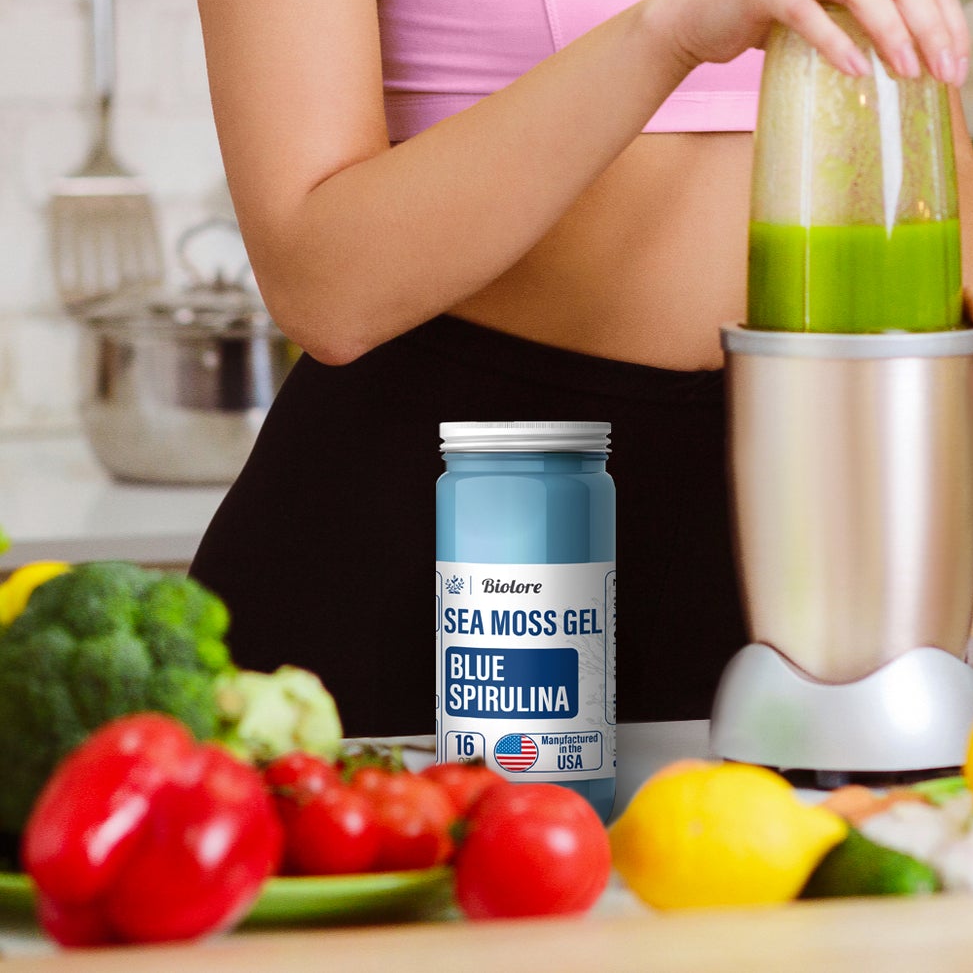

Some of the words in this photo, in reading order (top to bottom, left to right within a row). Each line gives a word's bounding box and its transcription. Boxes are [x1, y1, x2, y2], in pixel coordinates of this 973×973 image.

[481, 577, 543, 594] Biolore
[444, 607, 484, 635] SEA
[491, 609, 557, 636] MOSS
[563, 608, 603, 636] GEL
[450, 653, 505, 681] BLUE
[449, 683, 570, 713] SPIRULINA
[455, 734, 475, 756] 16
[541, 733, 599, 746] Manufactured
[559, 745, 568, 754] in
[570, 745, 582, 754] the
[557, 754, 583, 770] USA
